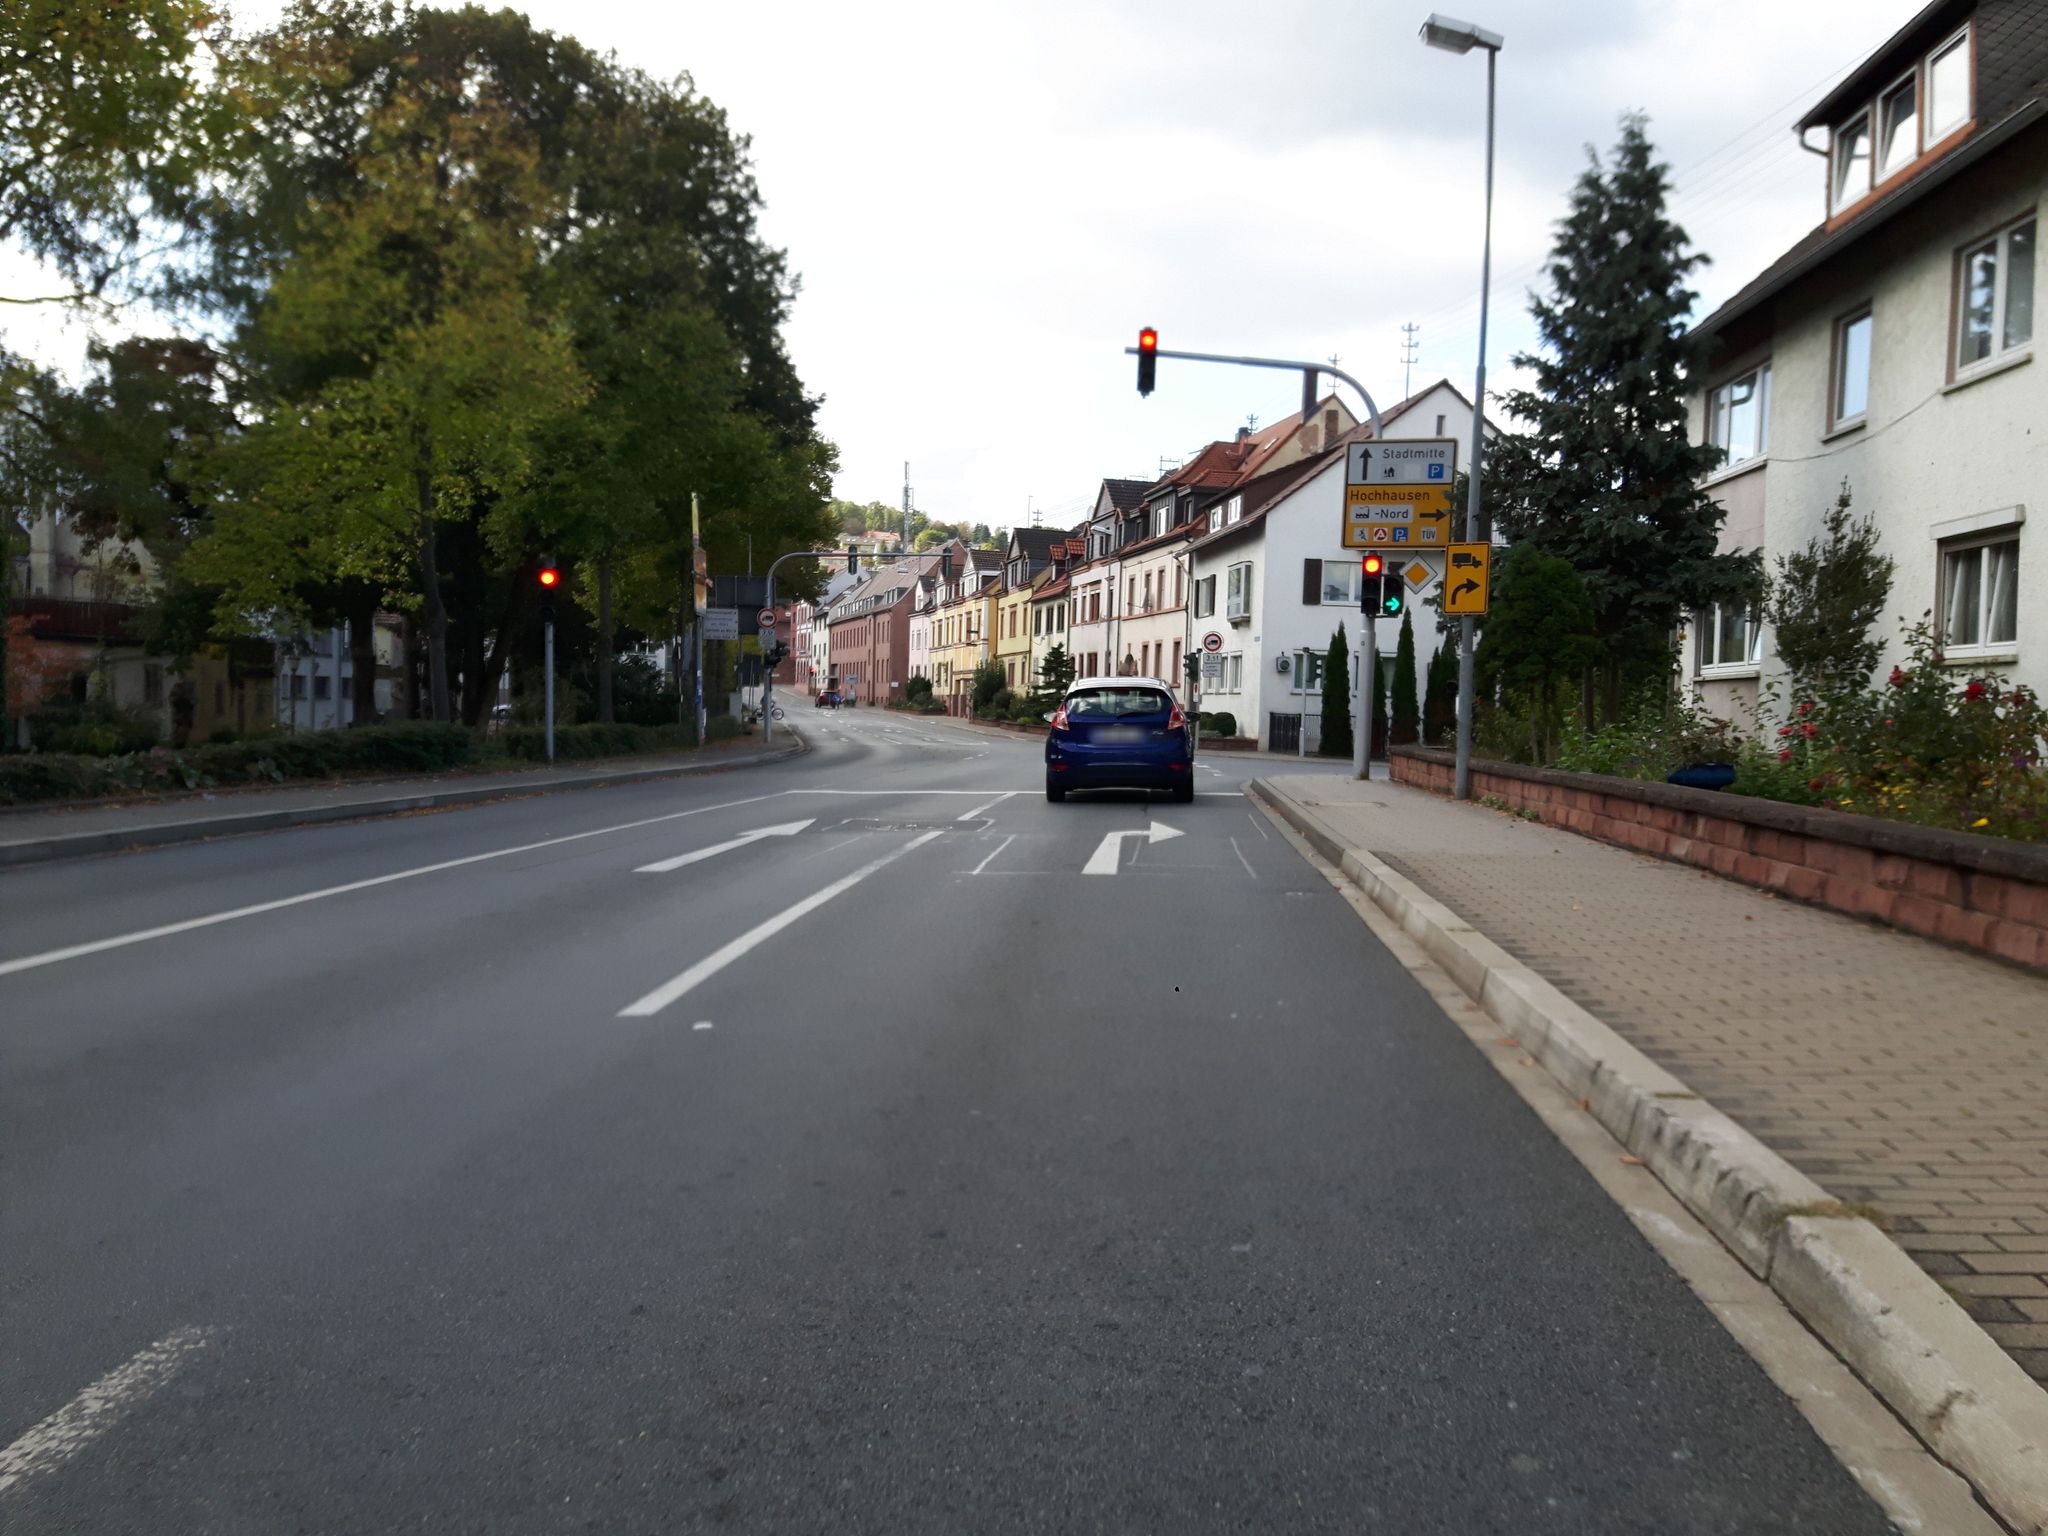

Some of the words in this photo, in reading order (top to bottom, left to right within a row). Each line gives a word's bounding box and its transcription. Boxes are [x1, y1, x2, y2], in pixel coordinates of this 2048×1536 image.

[1383, 448, 1445, 459] Stadtmitte
[1431, 466, 1440, 476] P
[1350, 490, 1430, 501] Hochhausen
[1374, 509, 1409, 519] -Nord
[1421, 529, 1436, 540] TÜV
